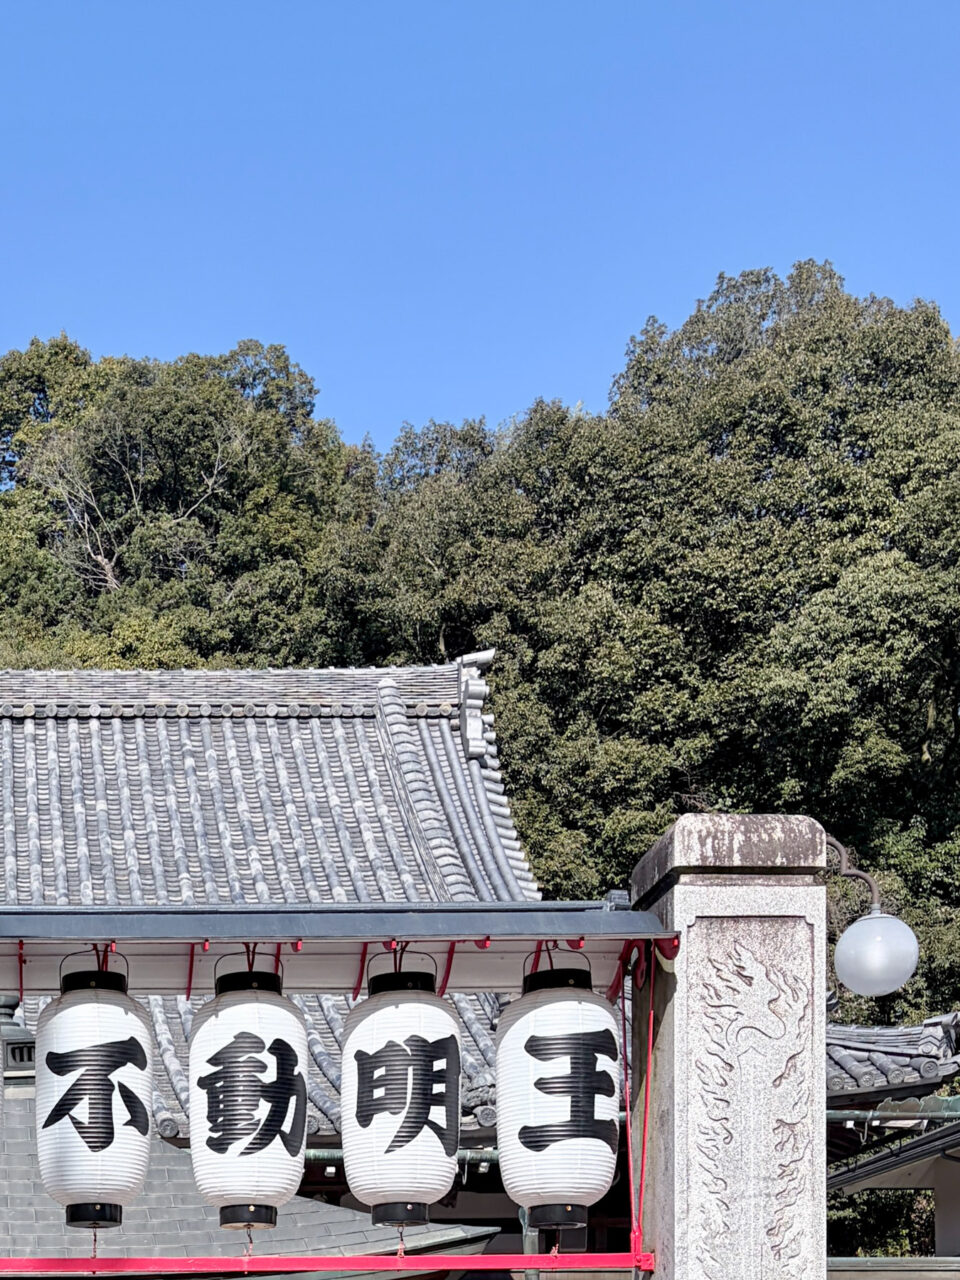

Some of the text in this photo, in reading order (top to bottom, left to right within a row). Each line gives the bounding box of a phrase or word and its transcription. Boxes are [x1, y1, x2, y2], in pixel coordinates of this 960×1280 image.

[41, 1035, 149, 1153] 不
[196, 1031, 306, 1157] 動
[353, 1033, 460, 1158] 明
[517, 1028, 619, 1155] 王
